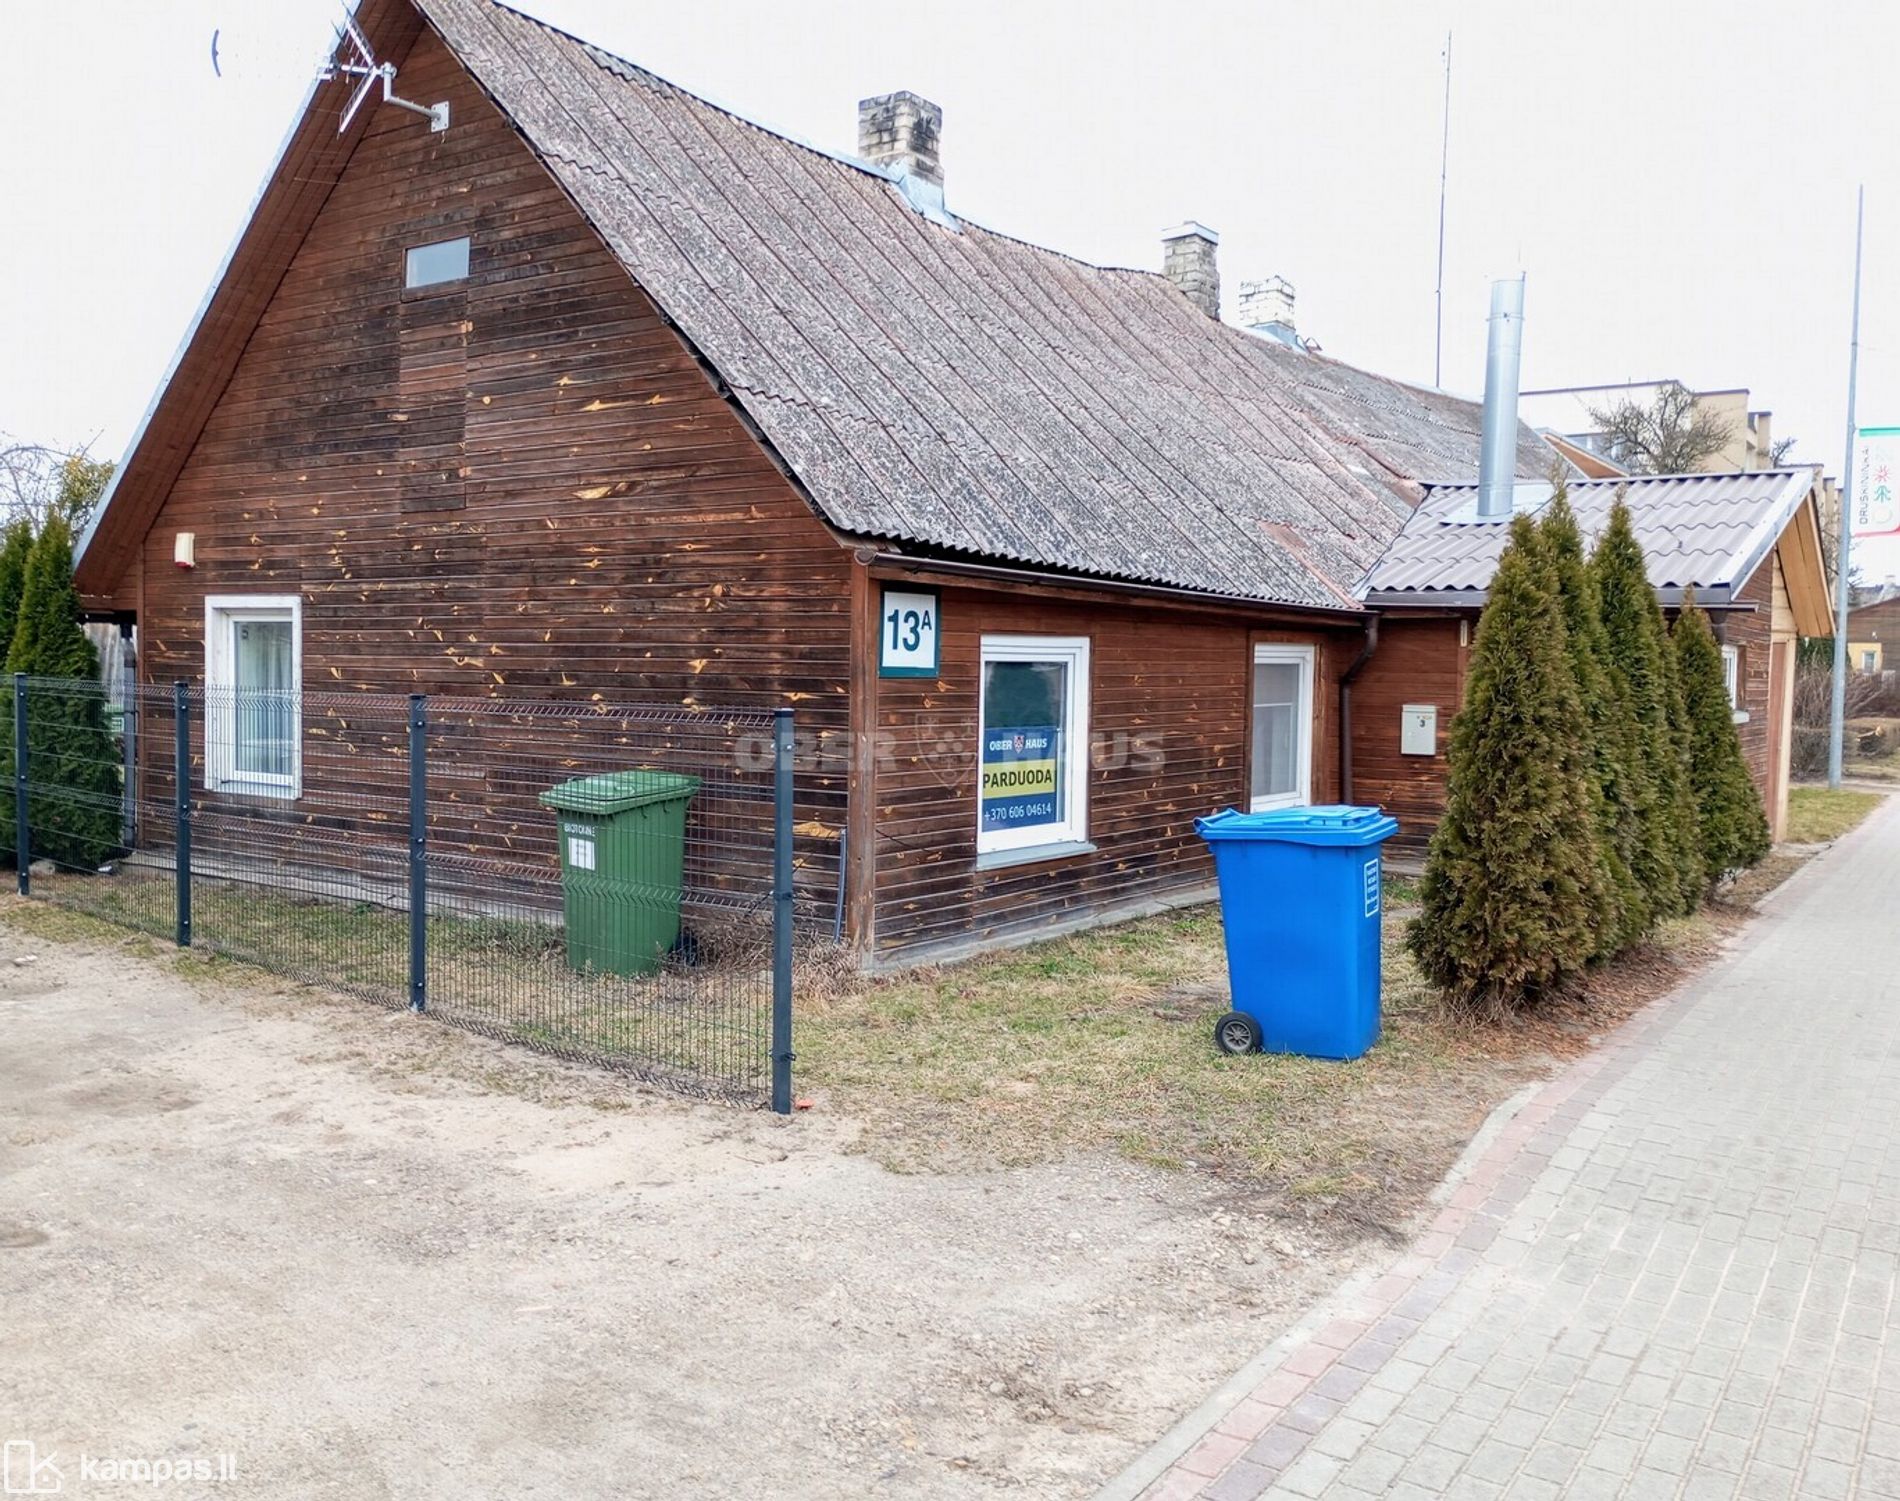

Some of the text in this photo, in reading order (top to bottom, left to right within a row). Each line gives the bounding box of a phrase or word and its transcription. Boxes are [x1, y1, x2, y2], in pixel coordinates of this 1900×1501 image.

[887, 609, 932, 651] 13A
[989, 738, 1048, 751] OBER HAUS
[983, 769, 1053, 788] PARDUODA
[984, 802, 1052, 820] +370 606 04614
